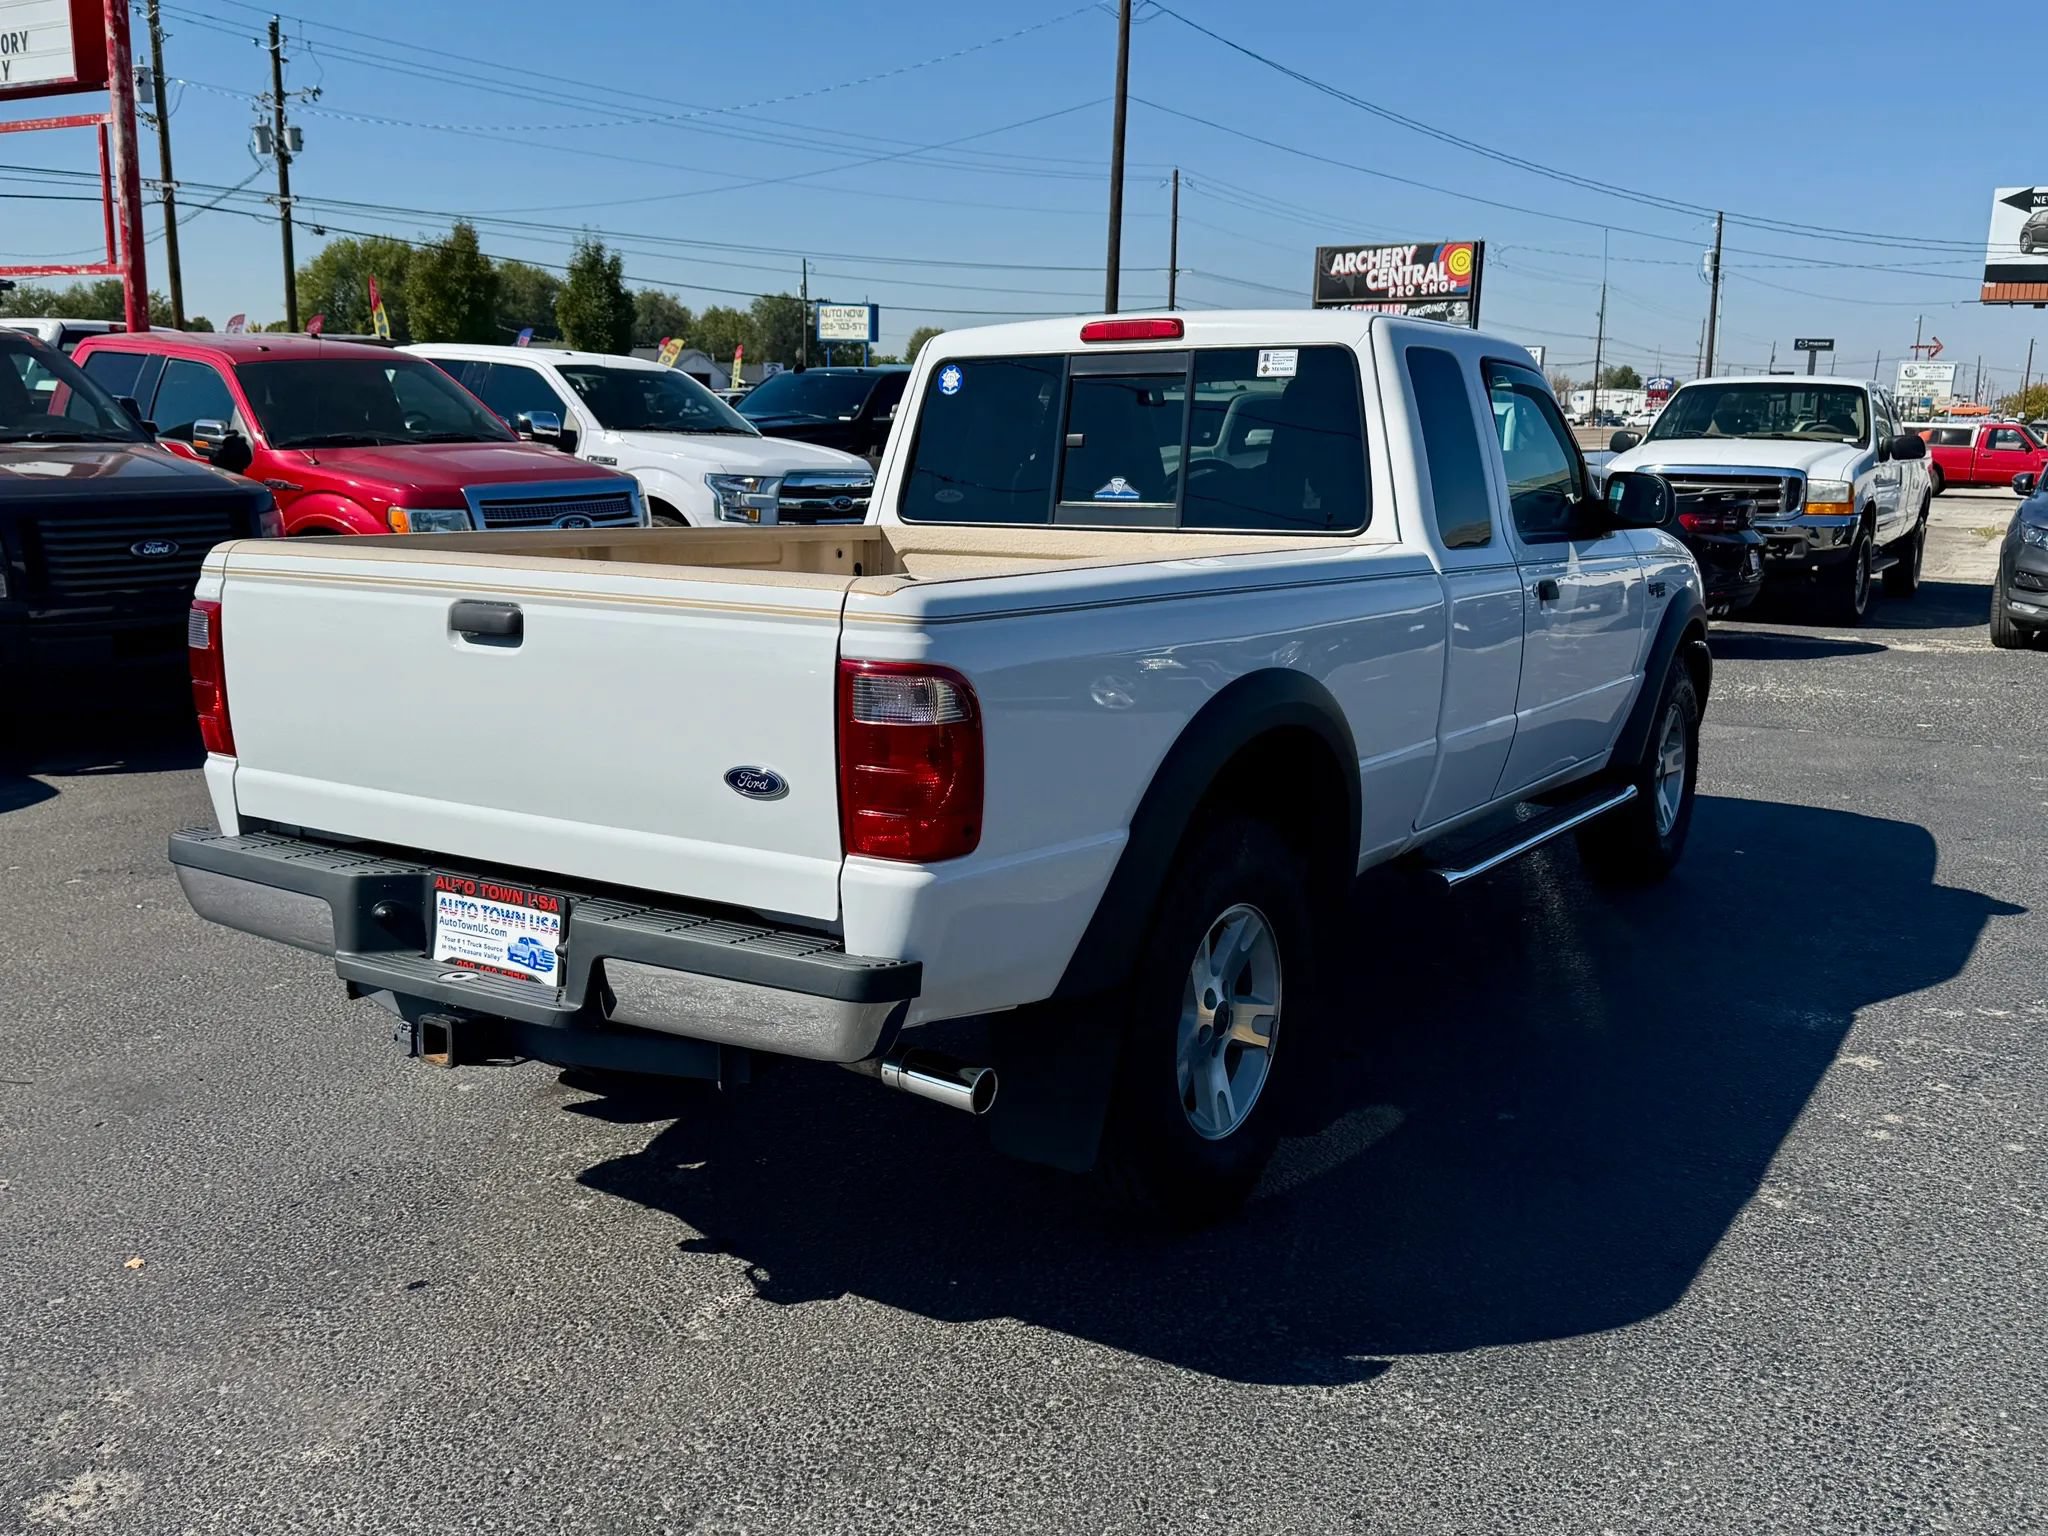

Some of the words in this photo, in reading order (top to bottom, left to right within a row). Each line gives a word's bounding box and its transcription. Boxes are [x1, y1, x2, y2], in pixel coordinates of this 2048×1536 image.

[1330, 245, 1417, 275] ARCHERY
[1366, 260, 1449, 291] CENTRAL
[1388, 285, 1414, 298] PRO
[1420, 280, 1457, 295] SHOP
[821, 308, 842, 318] AUTO
[843, 309, 865, 318] NOW
[143, 541, 169, 554] Ford
[737, 771, 769, 790] Ford
[434, 875, 476, 896] AUTO
[480, 884, 524, 905] TOWN
[527, 893, 559, 912] USA
[438, 897, 479, 921] AUTO
[480, 904, 526, 929] TOWN
[529, 914, 560, 937] USA
[439, 915, 508, 938] AutoTownUS.com
